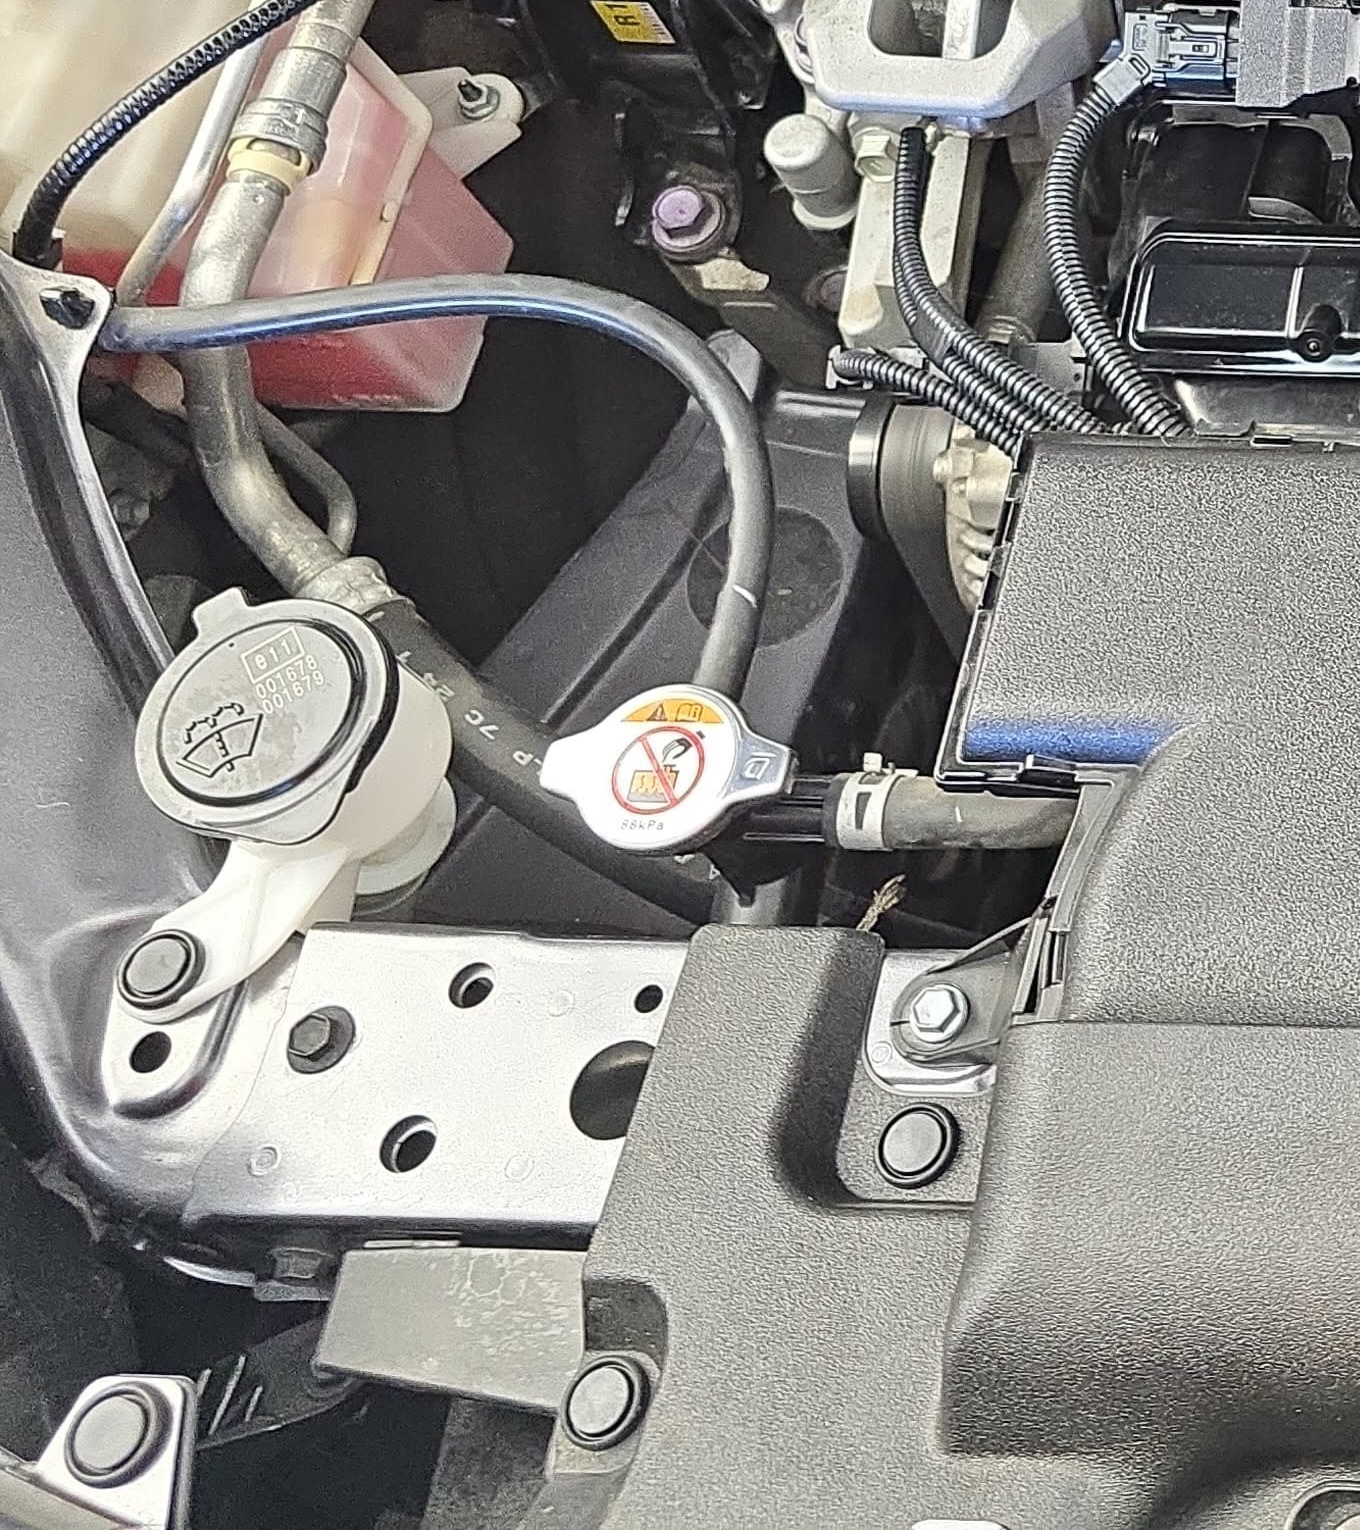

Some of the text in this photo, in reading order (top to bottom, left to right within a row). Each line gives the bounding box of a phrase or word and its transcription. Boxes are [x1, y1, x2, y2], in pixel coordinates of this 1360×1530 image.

[605, 4, 641, 26] R1
[255, 639, 291, 670] e11
[256, 655, 317, 699] 001678
[263, 670, 324, 714] 001679
[620, 819, 664, 831] 88kPa
